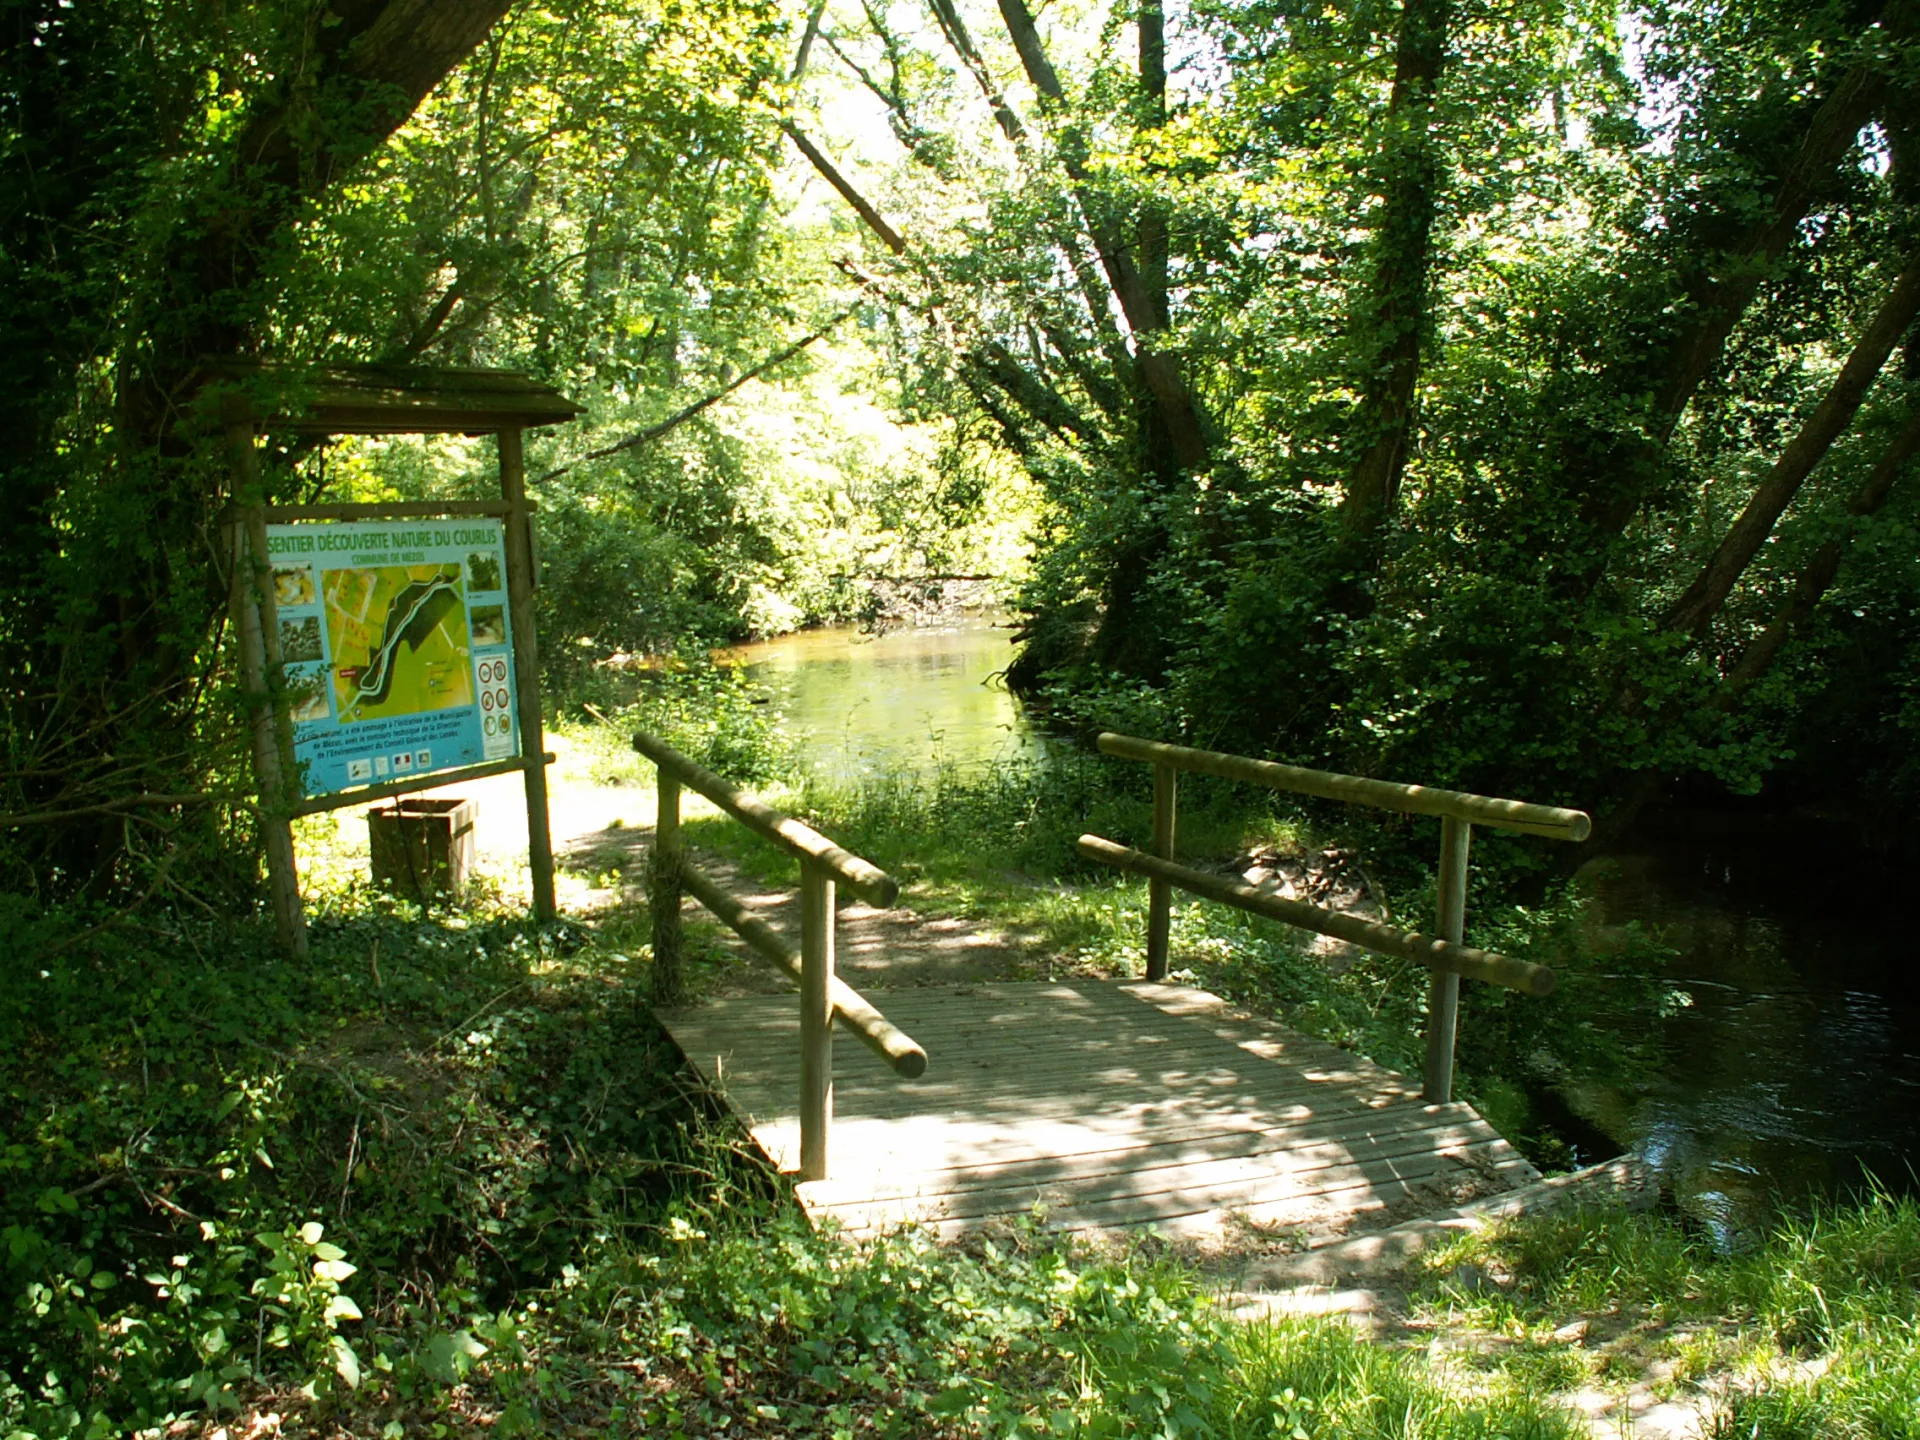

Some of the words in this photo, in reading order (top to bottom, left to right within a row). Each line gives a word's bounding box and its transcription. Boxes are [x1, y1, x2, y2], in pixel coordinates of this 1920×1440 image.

[266, 536, 314, 553] SENTIER
[318, 531, 388, 551] DÉCOUVERTE
[391, 531, 432, 548] NATURE
[434, 530, 450, 547] DU
[453, 528, 497, 546] COURLIS
[390, 552, 400, 563] DE
